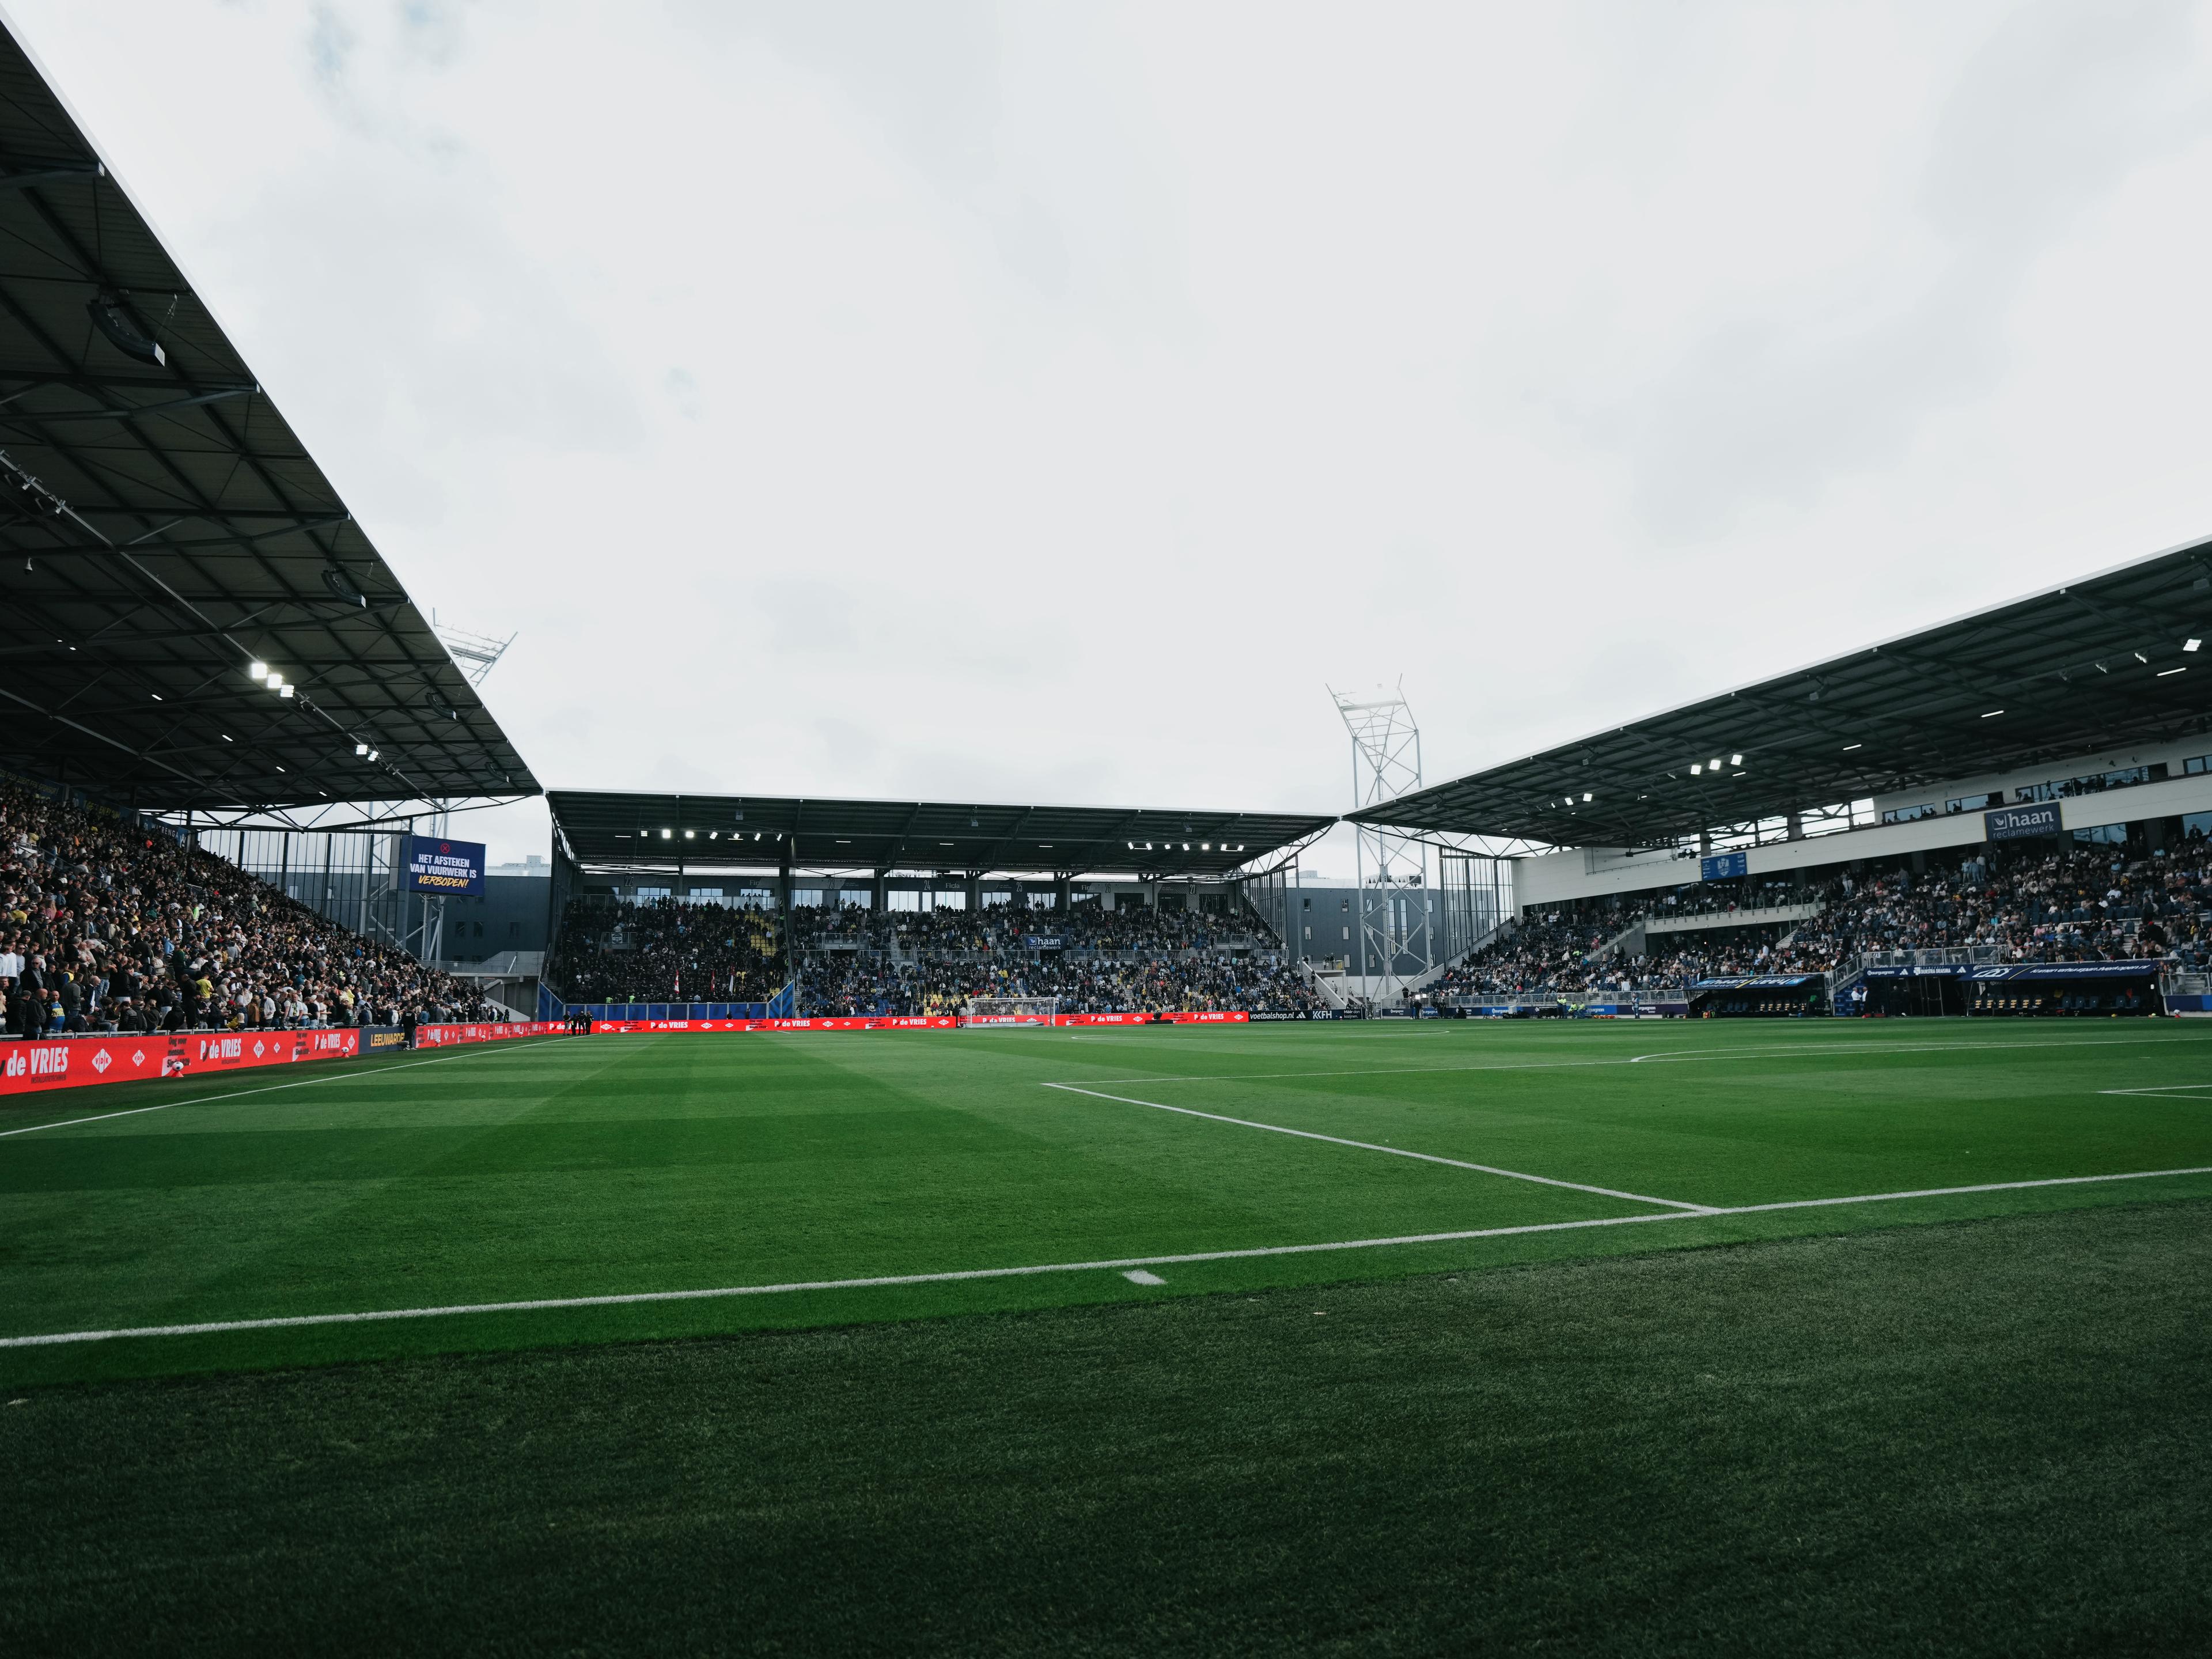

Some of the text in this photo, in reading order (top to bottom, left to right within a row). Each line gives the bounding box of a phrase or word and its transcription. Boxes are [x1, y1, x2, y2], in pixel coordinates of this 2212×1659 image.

[2008, 810, 2054, 828] haan
[1993, 824, 2054, 839] reclamewerk
[418, 854, 469, 868] HET AFSTEKEN
[410, 863, 477, 878] VAN VUURWERK IS
[418, 875, 469, 888] VERBODEN!
[924, 880, 931, 891] 24
[1016, 882, 1023, 892] 25
[1105, 883, 1111, 893] 26
[1037, 937, 1061, 945] haan
[1250, 1012, 1294, 1020] voetbalshop.nl
[320, 1035, 327, 1049] de
[328, 1033, 340, 1048] VRIES
[209, 1040, 219, 1059] de
[221, 1038, 241, 1058] VRIES
[6, 1046, 69, 1077] de VRIES
